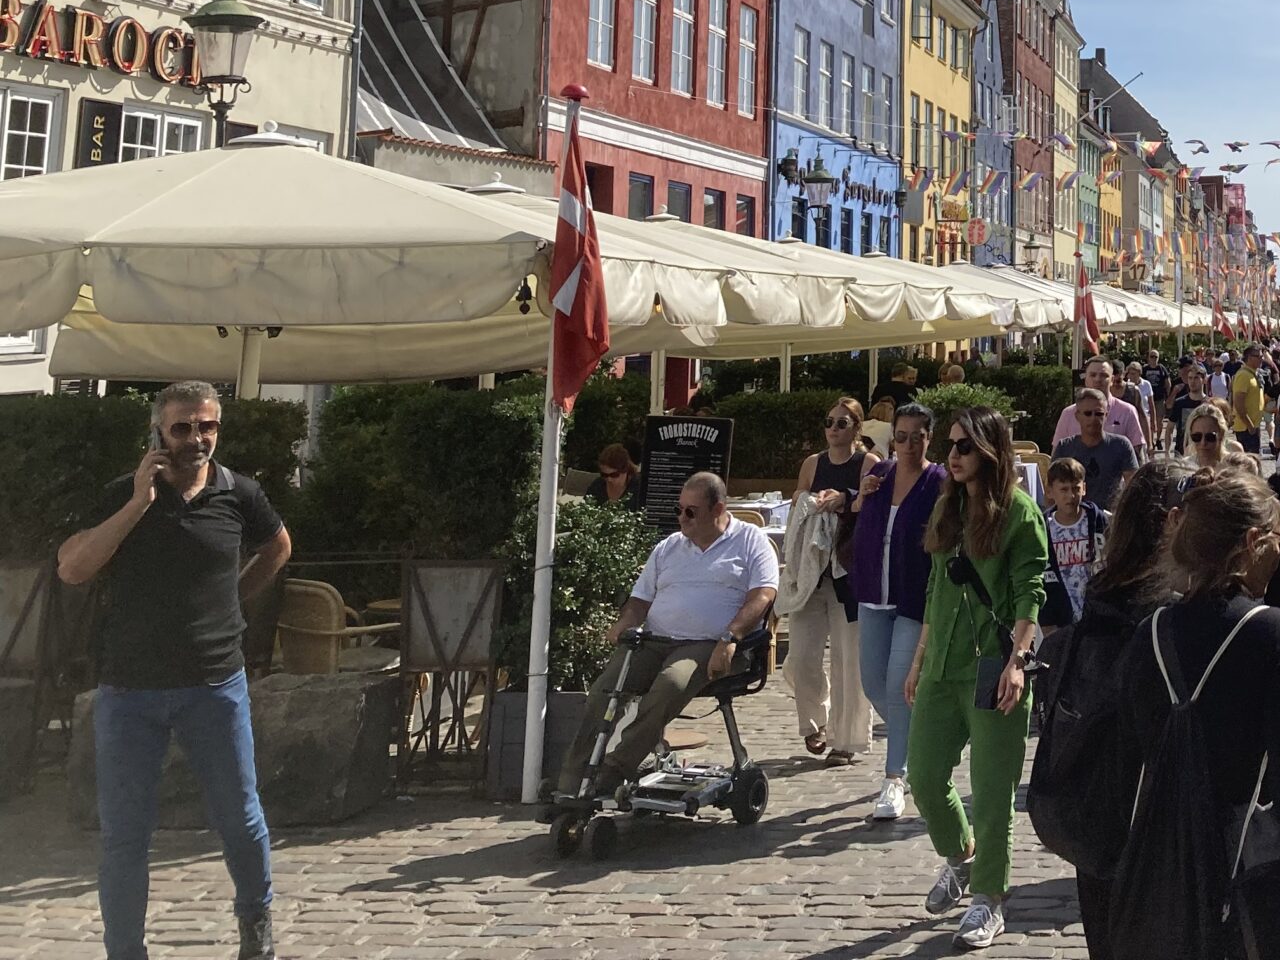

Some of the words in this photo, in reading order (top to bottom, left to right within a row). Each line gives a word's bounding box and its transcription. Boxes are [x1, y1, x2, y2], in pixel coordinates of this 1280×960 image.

[91, 114, 105, 162] BAR
[1129, 263, 1146, 280] 17
[658, 423, 719, 443] FROKOSTRETTER
[1053, 540, 1090, 566] ARVE
